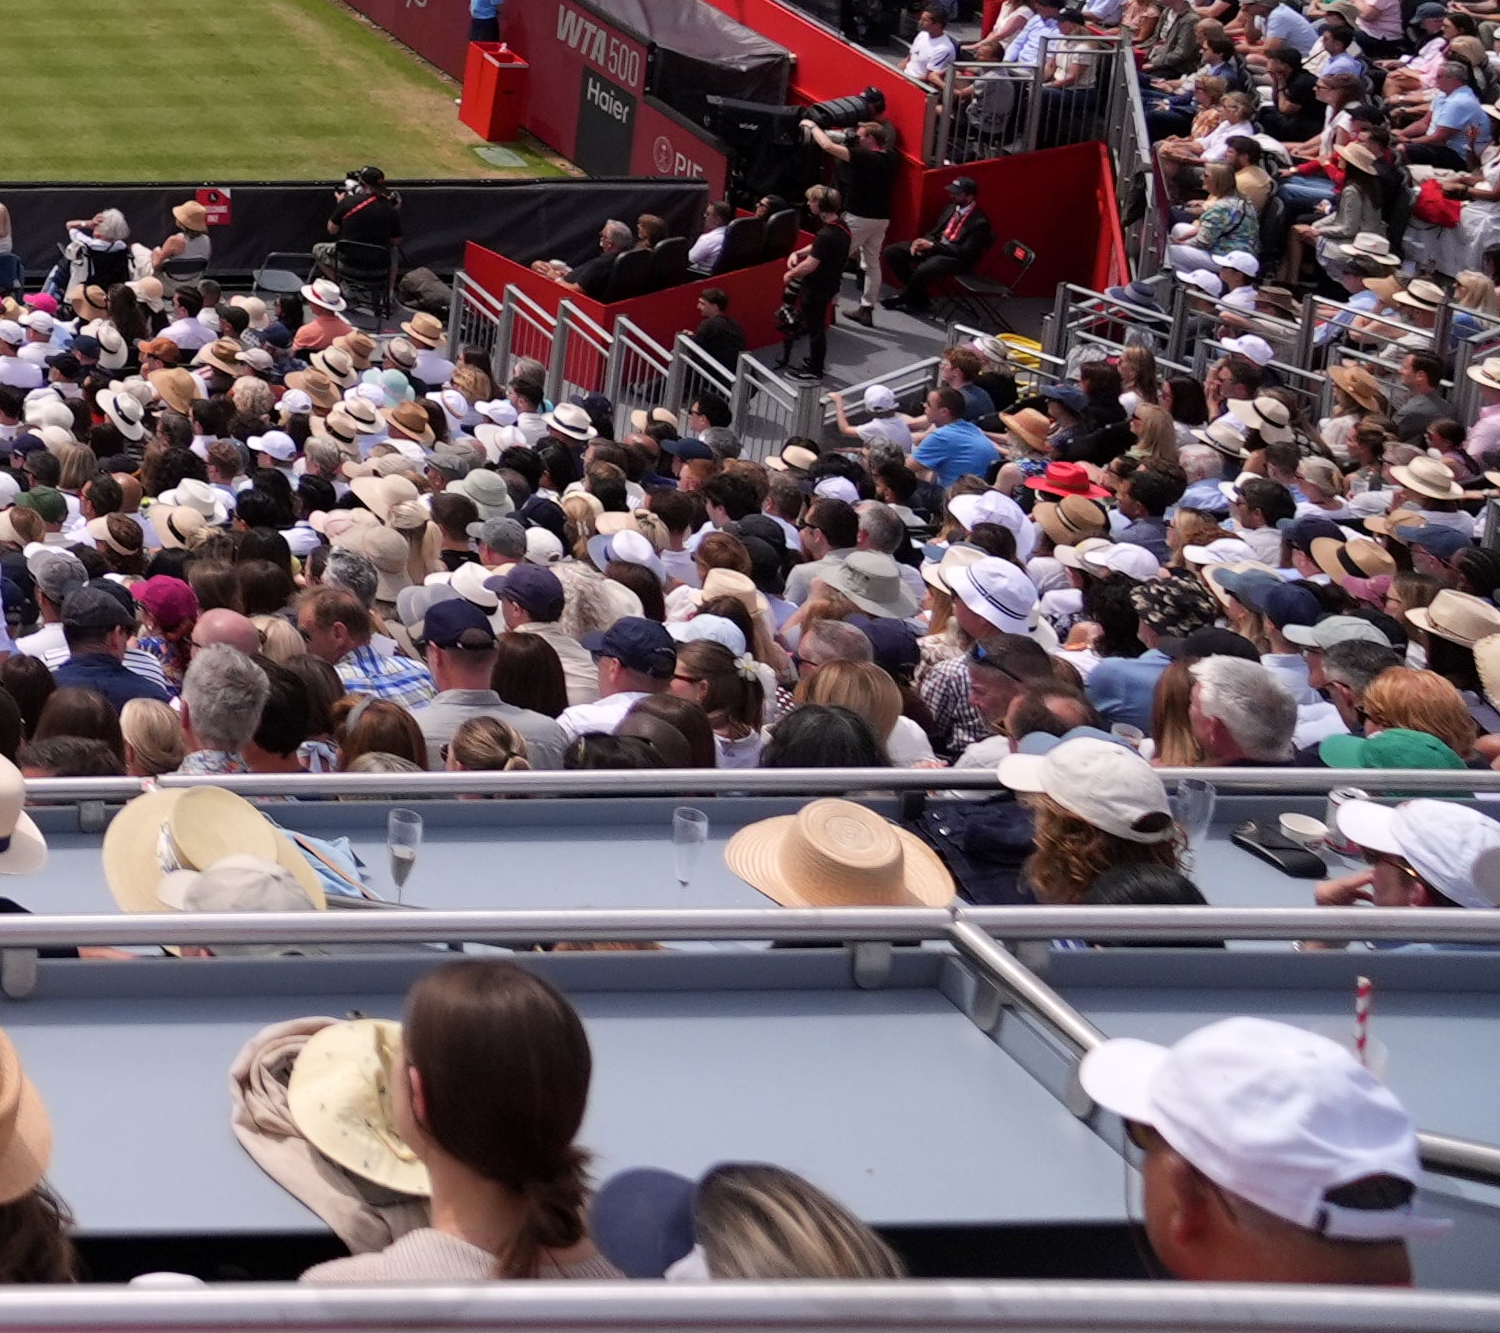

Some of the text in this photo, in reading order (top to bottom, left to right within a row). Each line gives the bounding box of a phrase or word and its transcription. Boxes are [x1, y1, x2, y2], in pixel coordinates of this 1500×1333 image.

[556, 3, 641, 88] WTA 500
[586, 76, 630, 125] Haier
